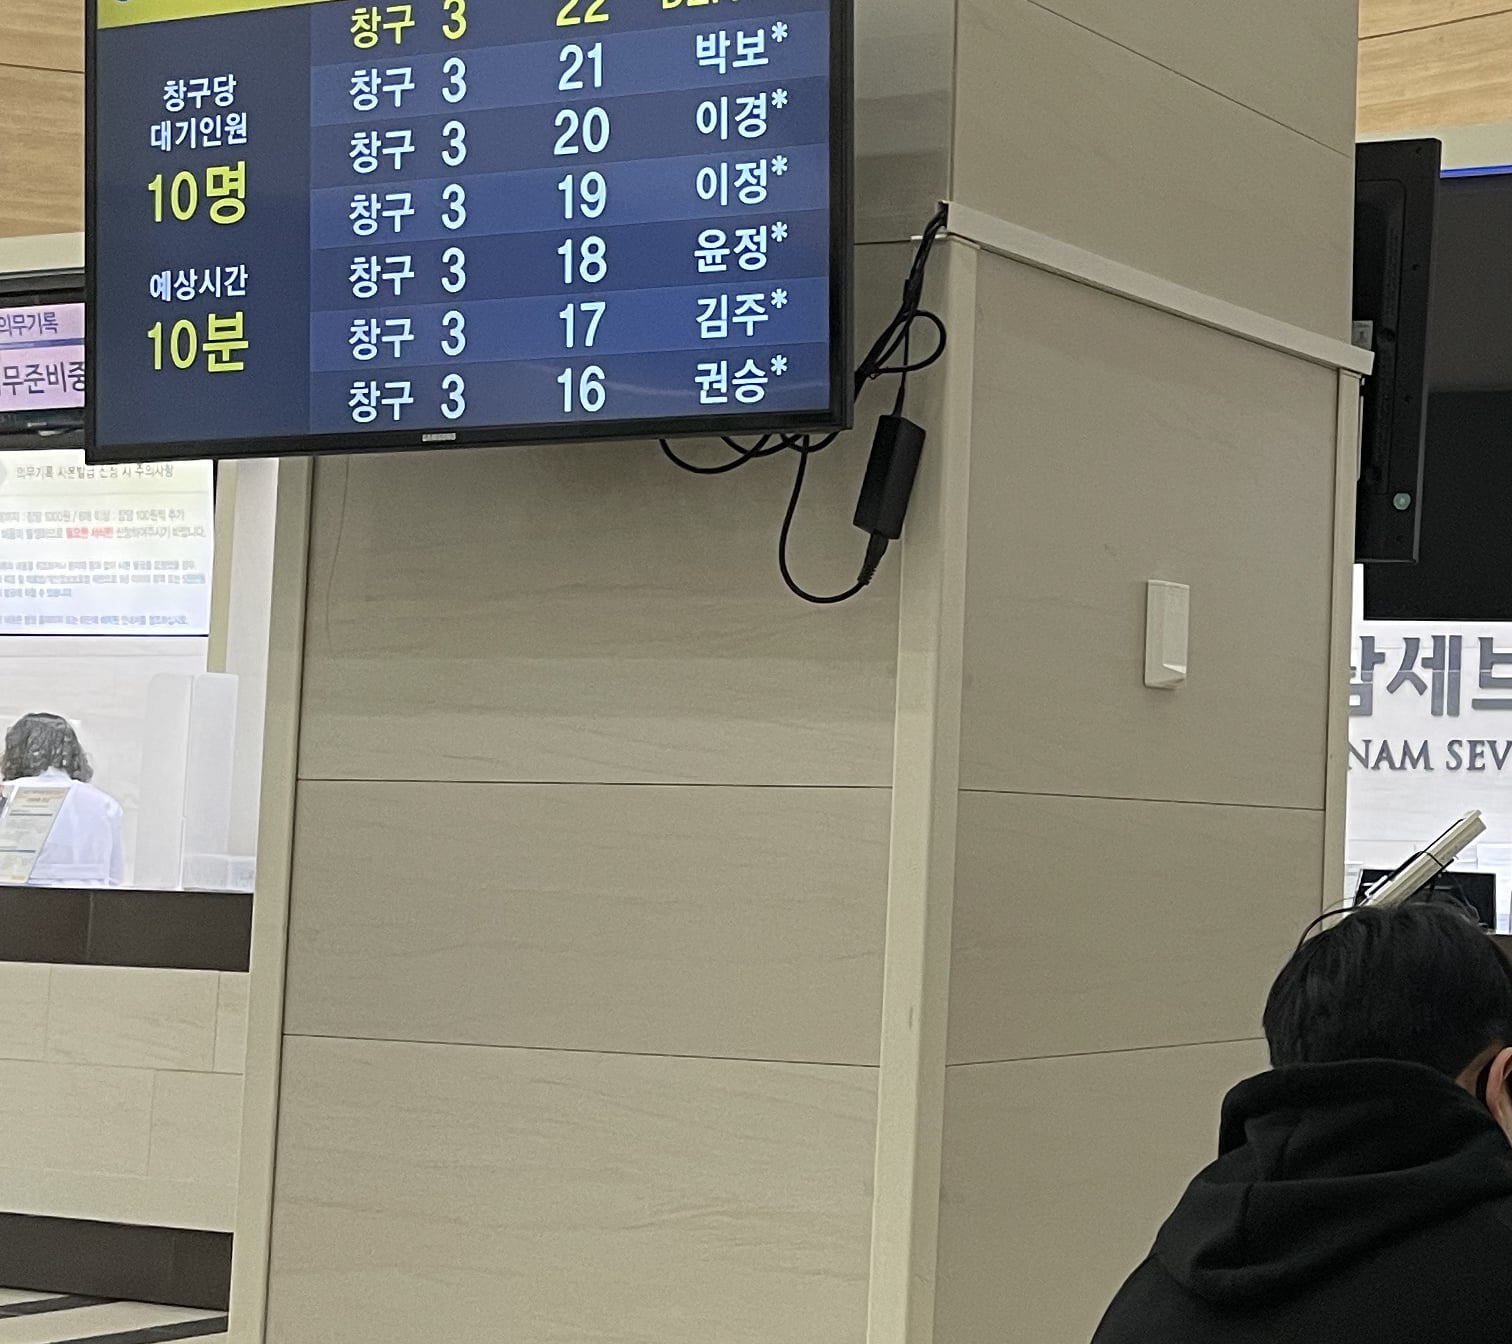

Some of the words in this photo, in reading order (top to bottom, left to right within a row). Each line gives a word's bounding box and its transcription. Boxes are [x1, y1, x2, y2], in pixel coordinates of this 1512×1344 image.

[350, 5, 416, 50] 창구
[162, 73, 238, 113] 창구당
[348, 66, 416, 112] 창구
[441, 56, 468, 104] 3
[557, 41, 604, 92] 21
[150, 112, 249, 153] 대기인원
[348, 129, 416, 174] 창구
[441, 119, 468, 167] 3
[553, 106, 611, 156] 20
[147, 160, 249, 226] 10명
[348, 192, 416, 237] 창구
[440, 182, 467, 231] 3
[557, 171, 608, 220] 19
[149, 264, 249, 303] 예상시간
[348, 255, 416, 299] 창구
[440, 246, 467, 294] 3
[557, 235, 608, 285] 18
[0, 311, 59, 336] 의무기록
[147, 311, 250, 374] 10분
[348, 317, 415, 362] 창구
[440, 309, 467, 357] 3
[559, 301, 607, 349] 17
[0, 361, 85, 396] 무준비중
[347, 380, 415, 424] 창구
[440, 373, 466, 421] 3
[557, 365, 607, 414] 16
